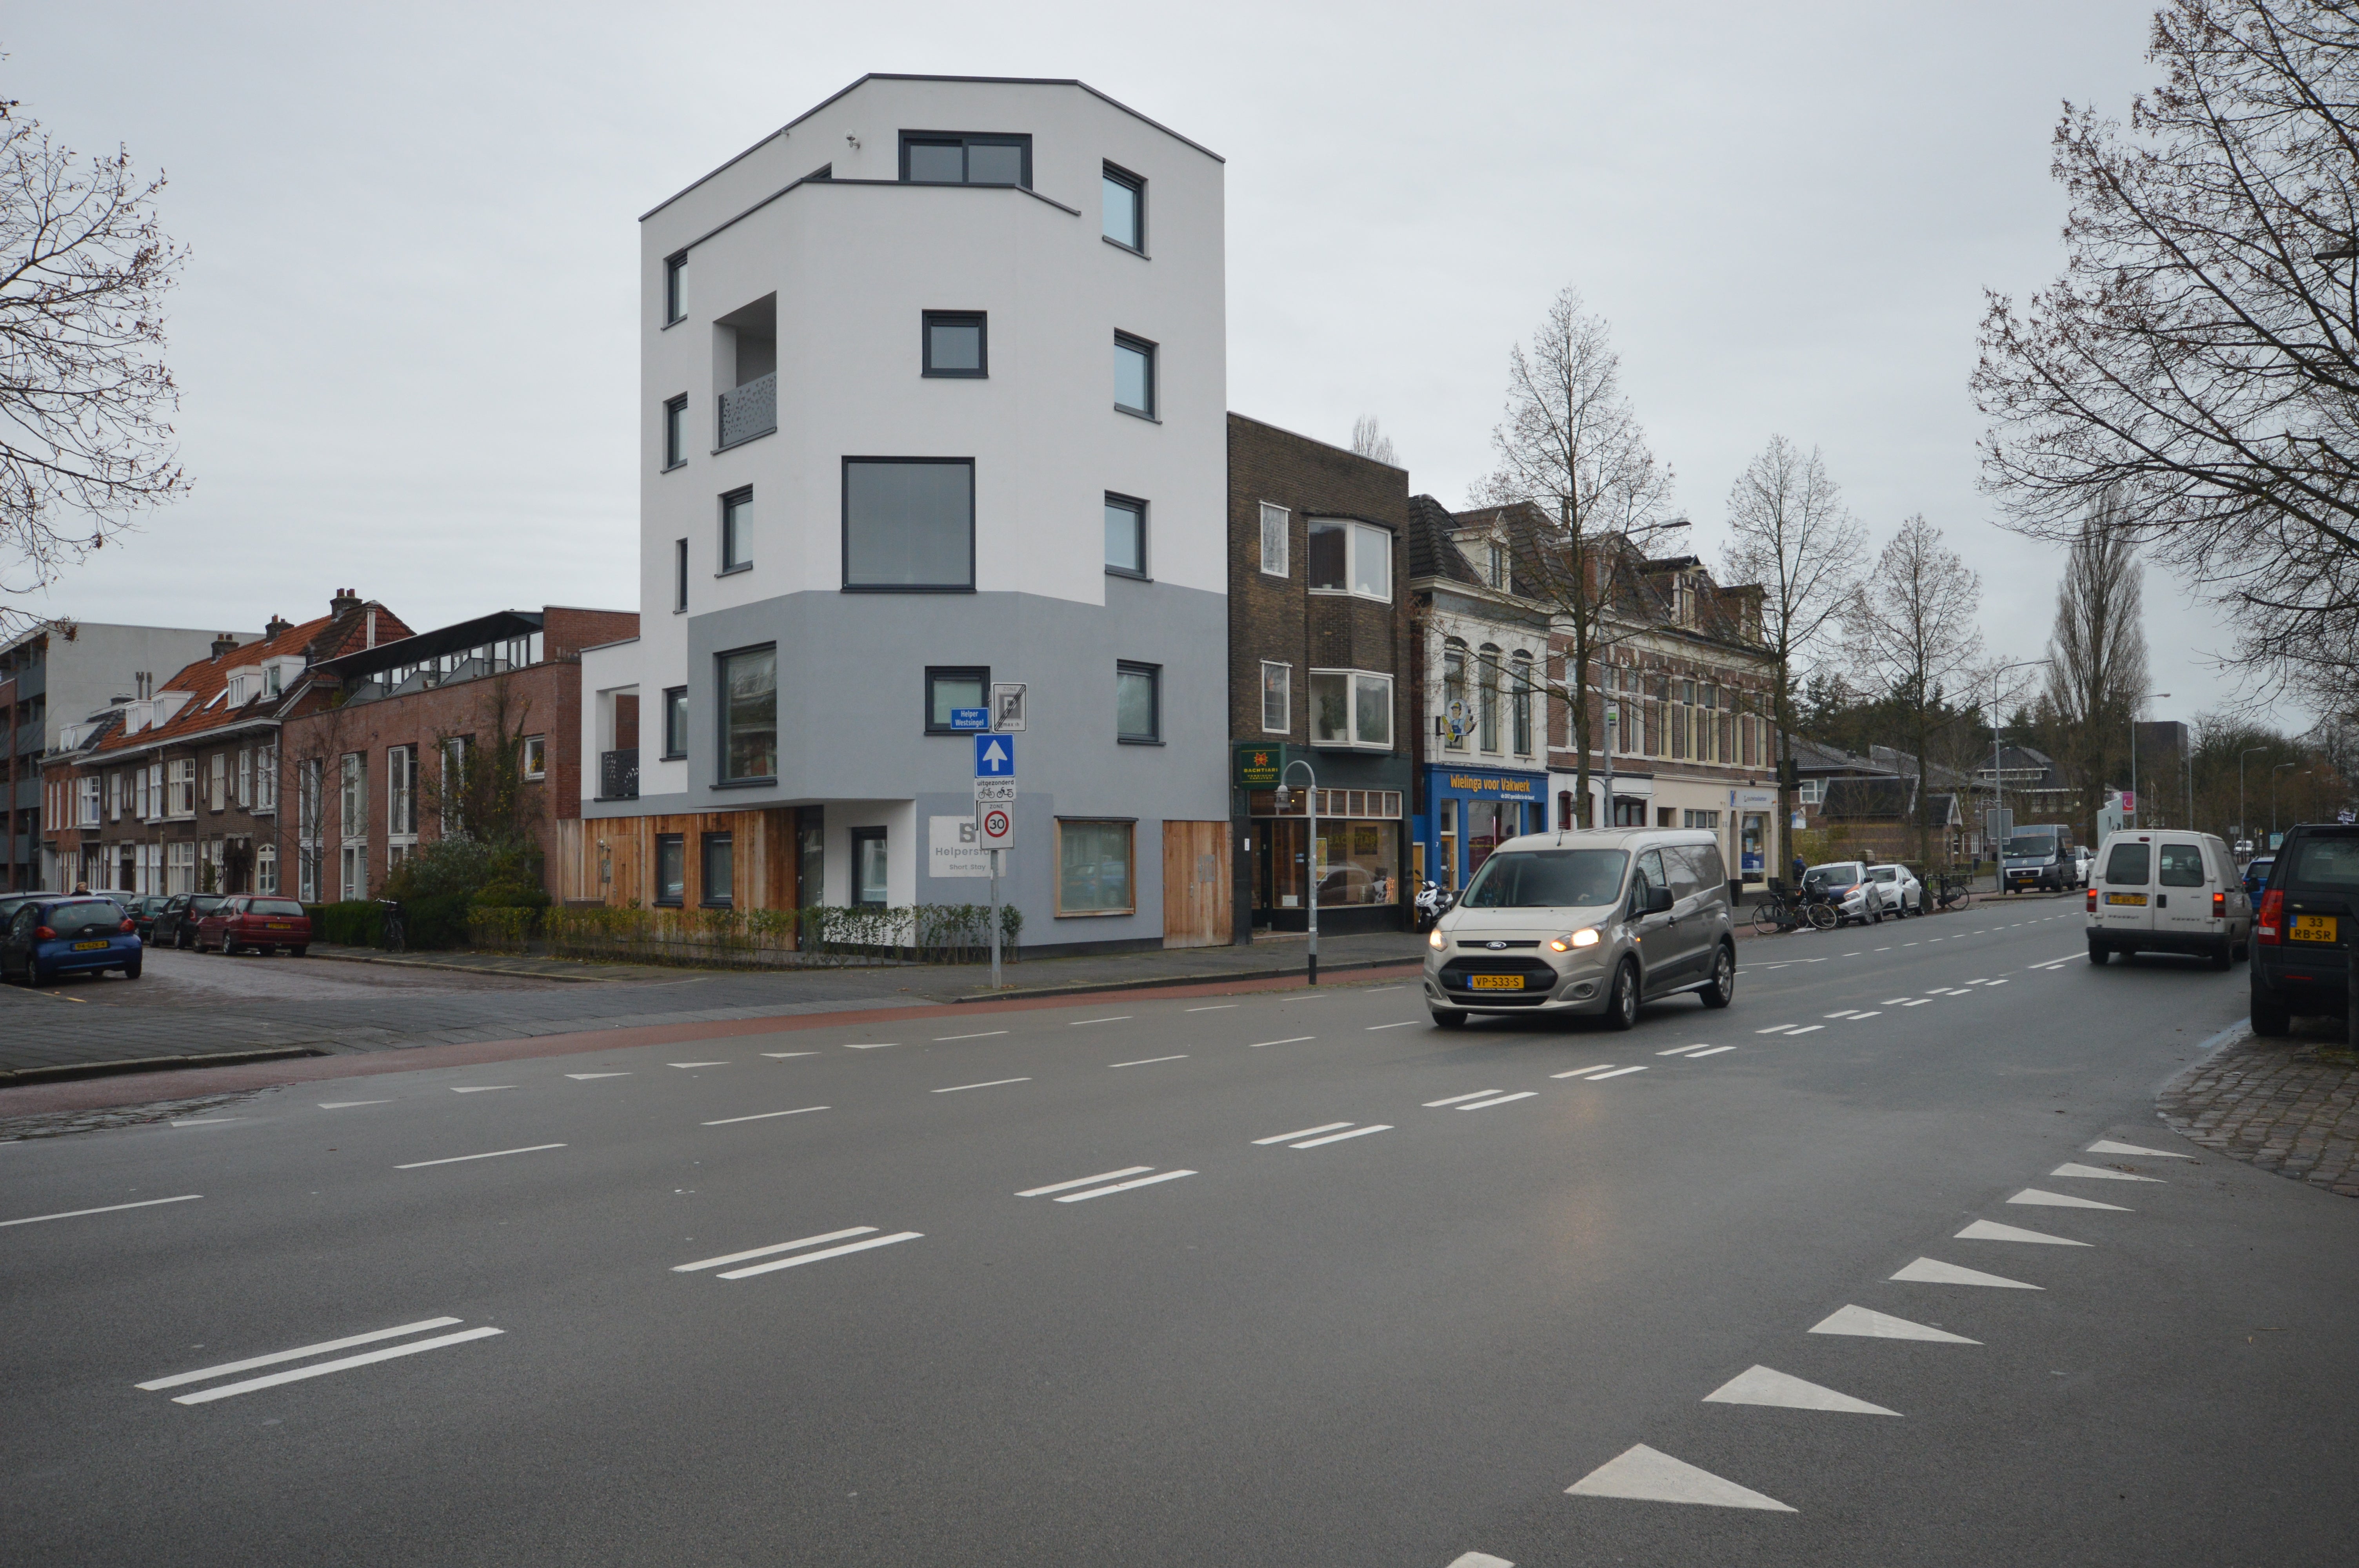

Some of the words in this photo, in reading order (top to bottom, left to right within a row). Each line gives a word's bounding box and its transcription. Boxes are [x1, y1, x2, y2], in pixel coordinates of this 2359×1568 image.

[961, 710, 978, 719] Helper
[955, 719, 984, 727] Westsingel
[1450, 774, 1481, 792] Wielinga
[1483, 779, 1499, 790] voor
[1501, 778, 1530, 792] Vakwerk
[990, 819, 1005, 829] 30
[2309, 918, 2323, 927] 33
[2295, 929, 2331, 940] RB-SR
[1476, 977, 1519, 986] VP-533-S
